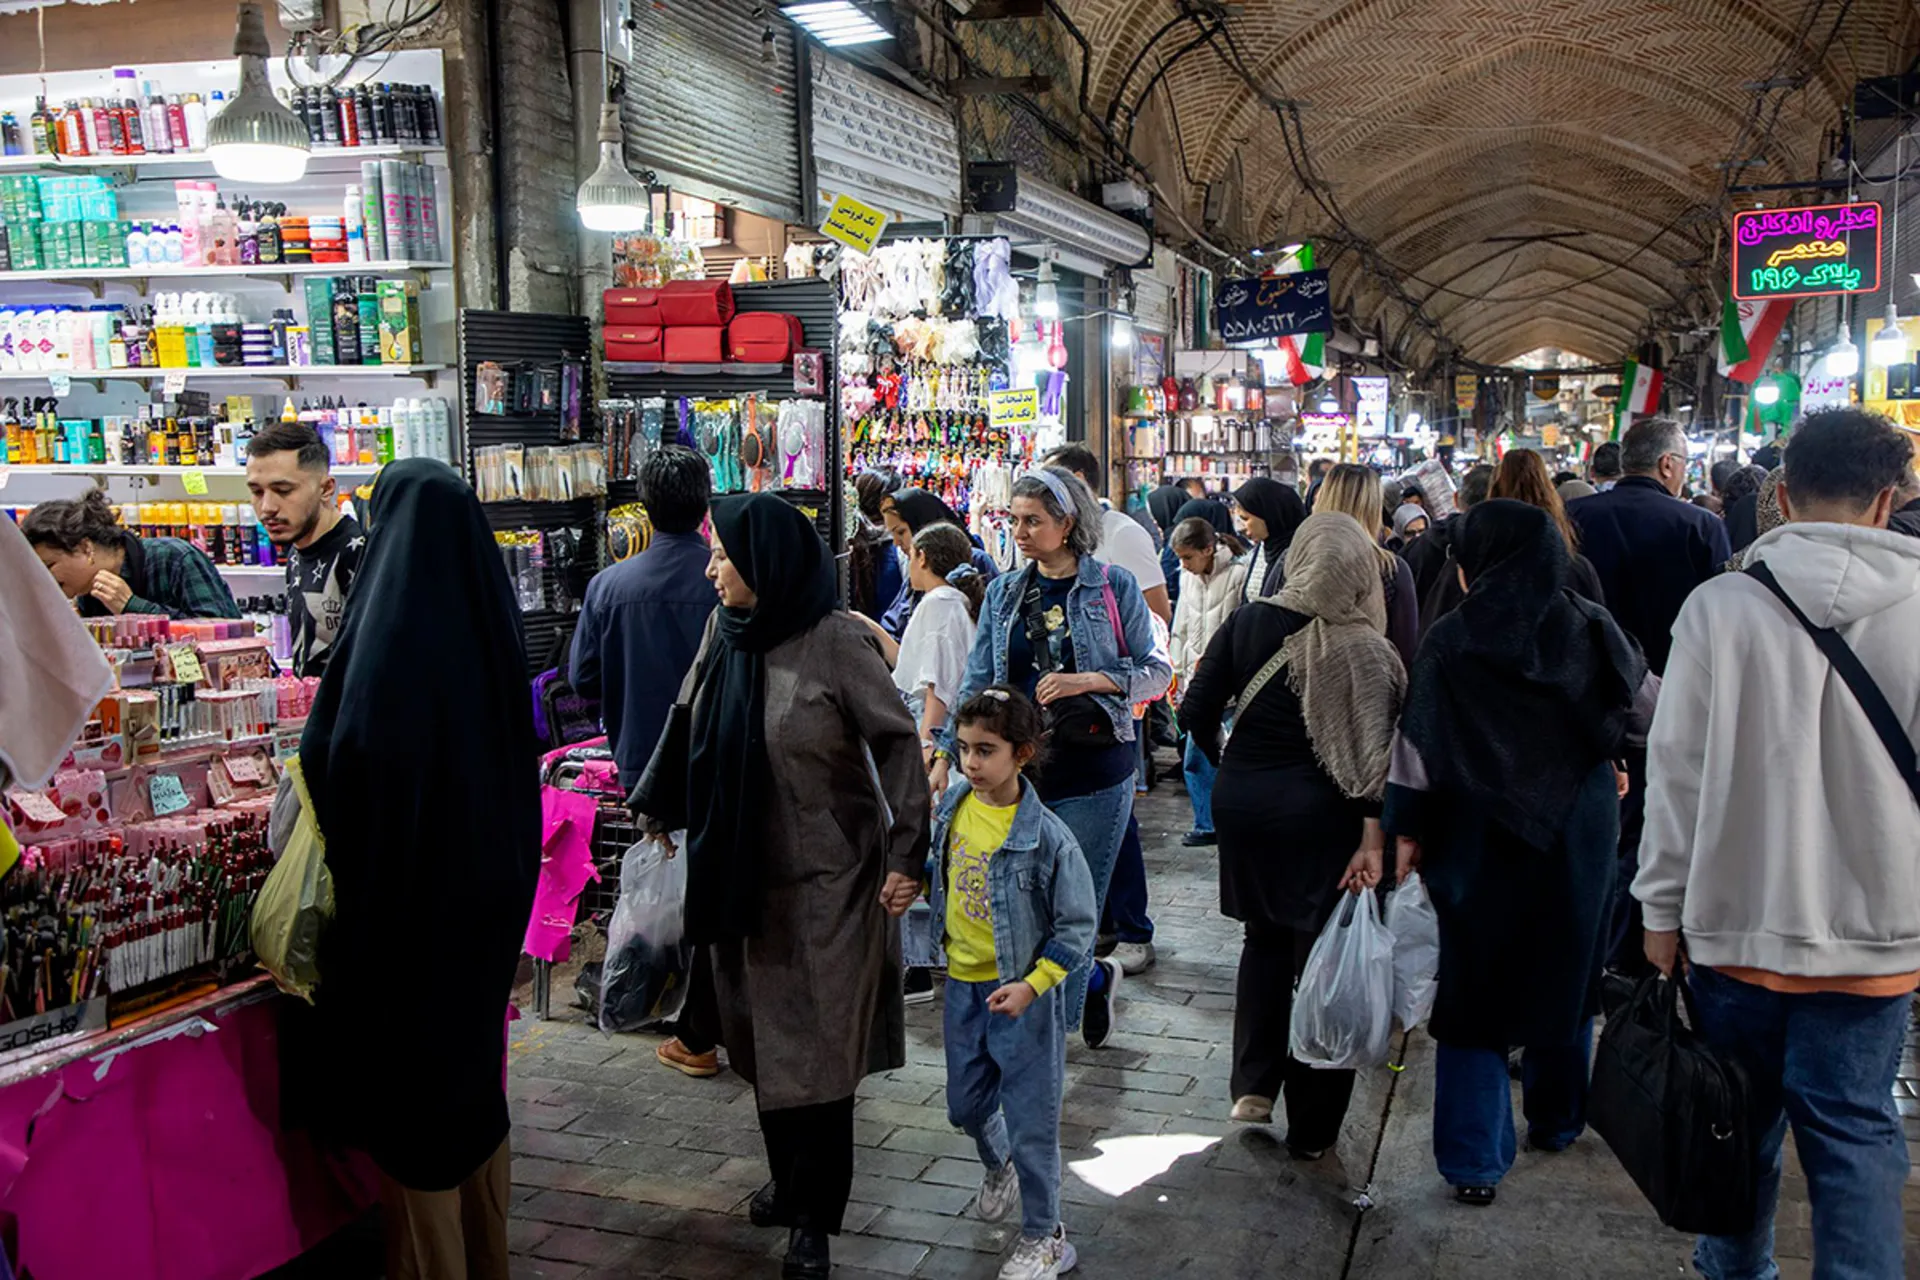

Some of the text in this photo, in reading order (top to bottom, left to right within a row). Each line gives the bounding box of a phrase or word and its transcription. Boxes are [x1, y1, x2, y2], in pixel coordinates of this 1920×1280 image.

[827, 217, 845, 230] عمده
[838, 206, 876, 226] تک فروشی
[845, 226, 864, 240] قیمت
[1738, 207, 1877, 246] عطر و ادکلن
[1766, 240, 1847, 268] معمر
[1751, 263, 1862, 291] پلاک ۱۹۶
[996, 393, 1033, 405] بدلیجات
[995, 408, 1036, 420] رنگ ثابت
